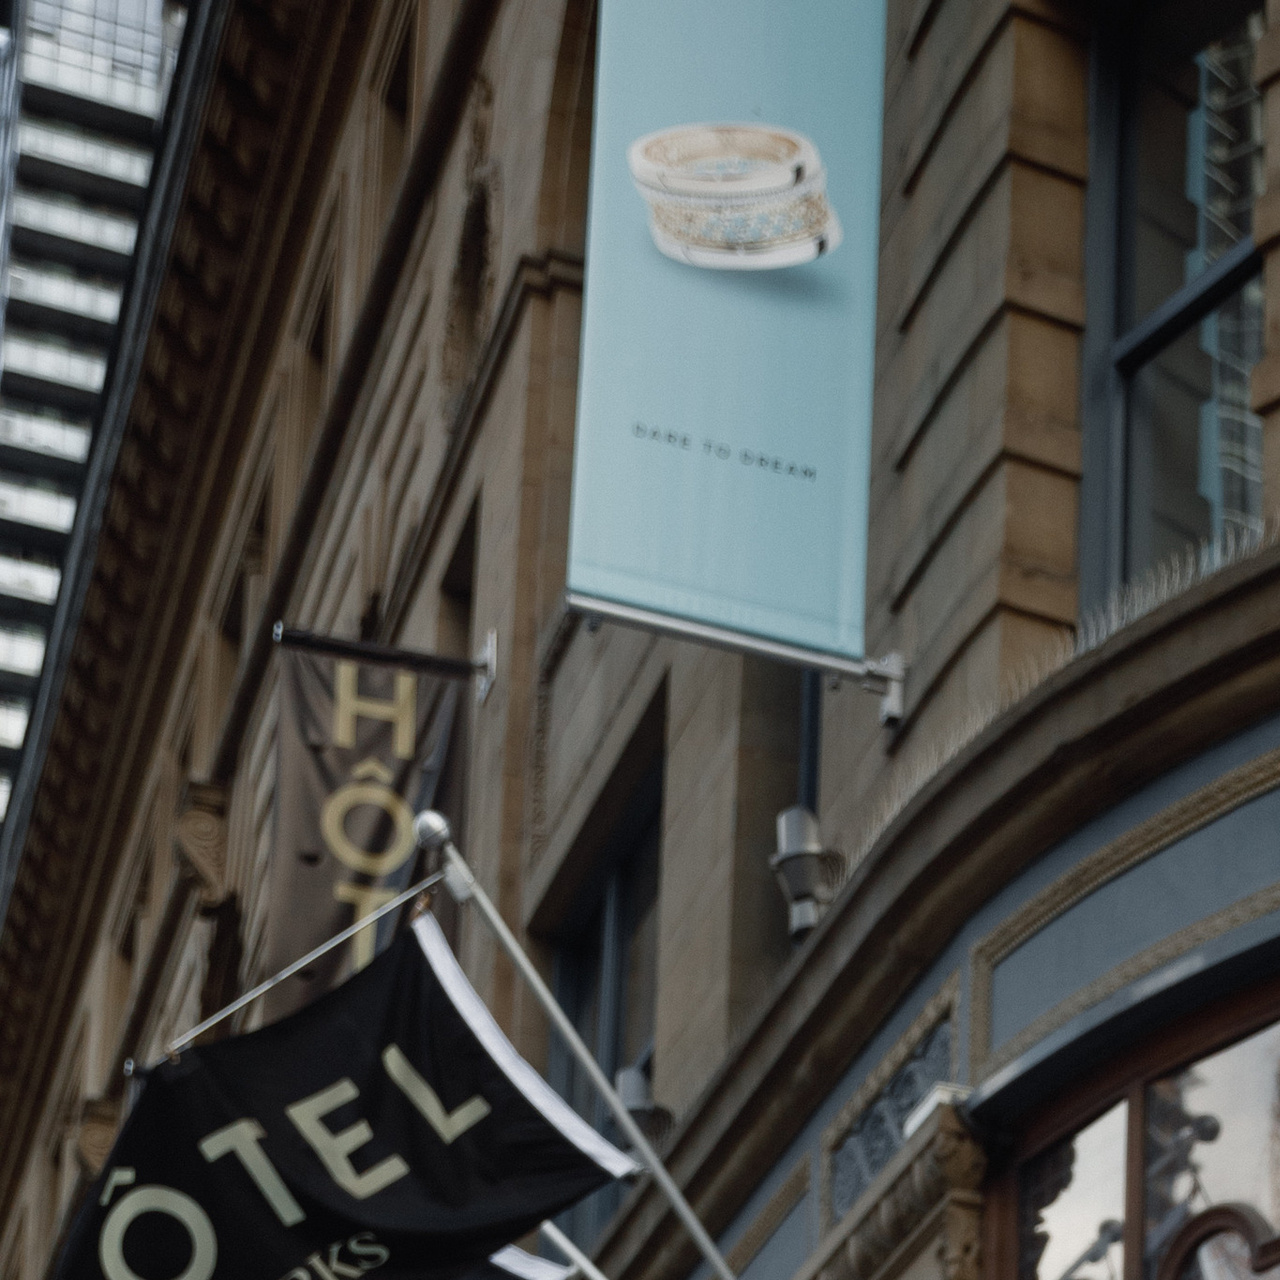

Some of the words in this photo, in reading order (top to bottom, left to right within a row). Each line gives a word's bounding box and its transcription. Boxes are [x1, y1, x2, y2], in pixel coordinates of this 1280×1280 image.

[631, 421, 692, 450] DARE
[703, 437, 731, 461] TO
[738, 448, 818, 483] DREAM
